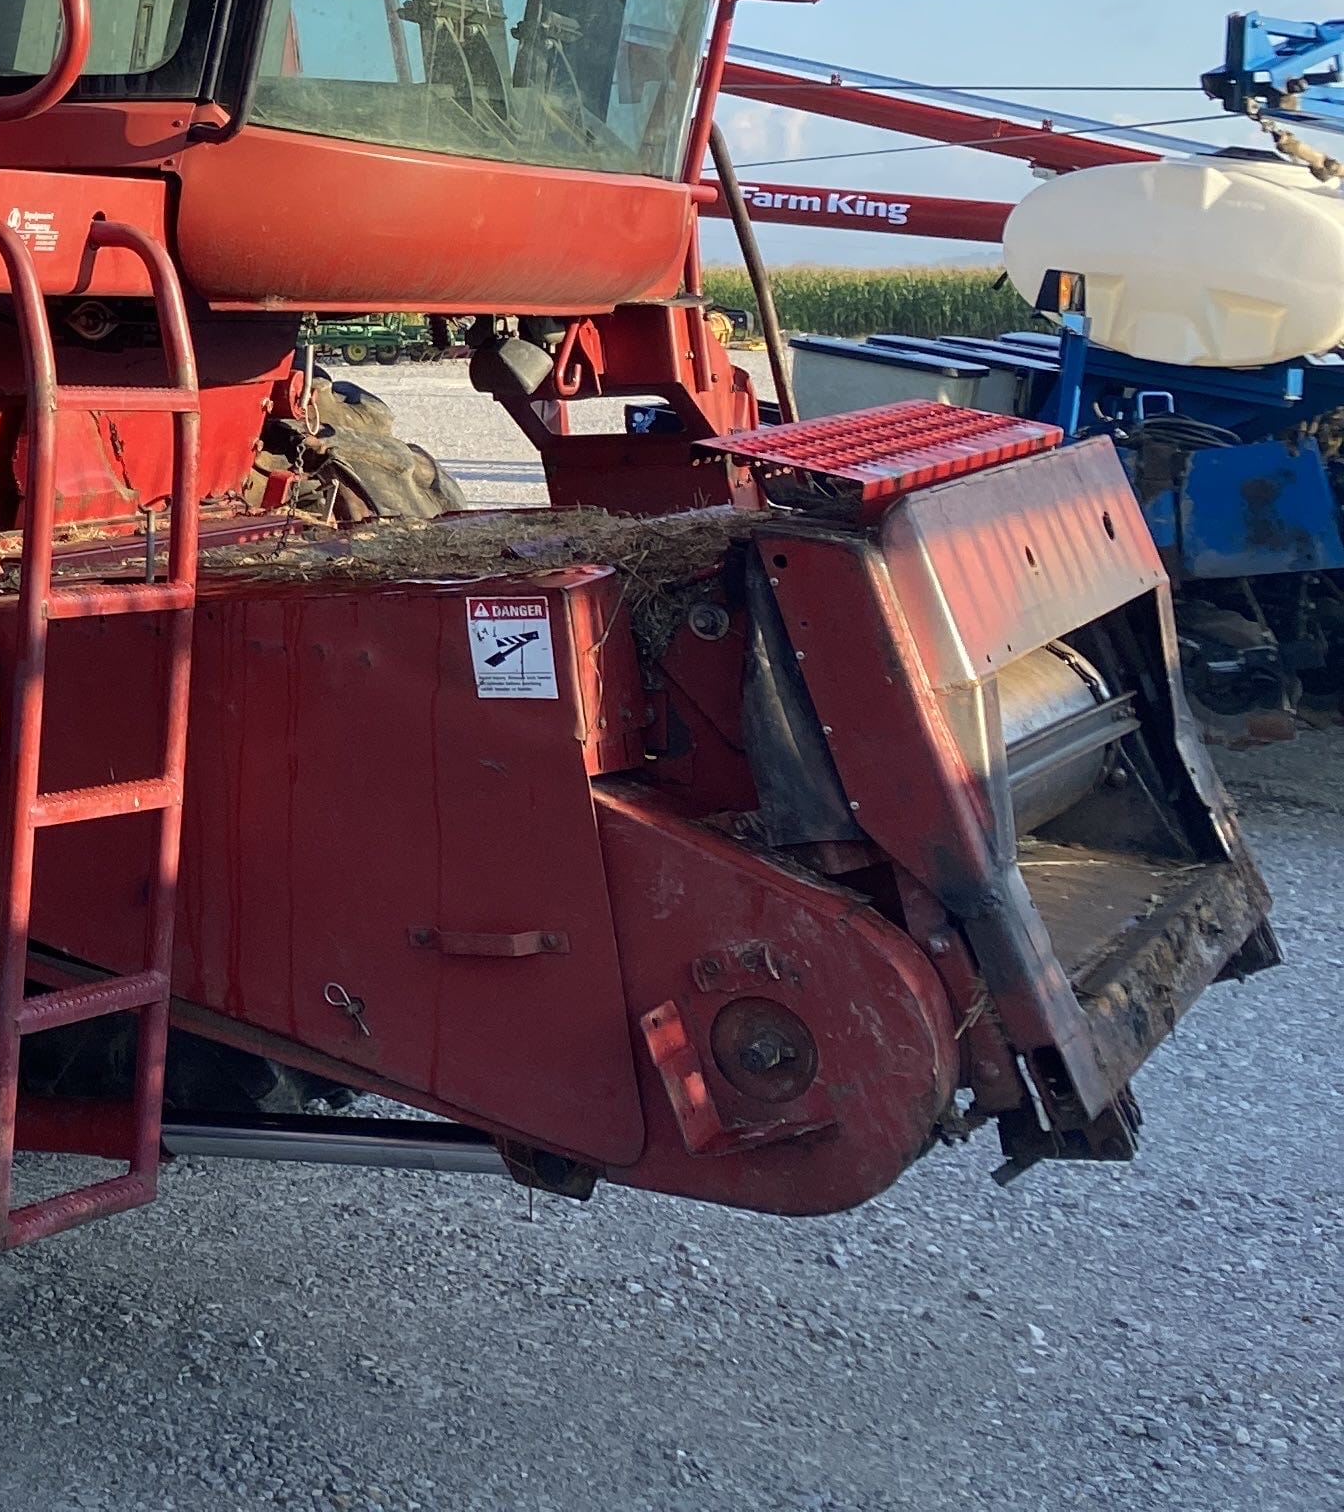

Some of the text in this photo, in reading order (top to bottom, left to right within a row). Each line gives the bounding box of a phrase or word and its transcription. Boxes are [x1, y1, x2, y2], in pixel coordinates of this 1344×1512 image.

[738, 185, 912, 226] Farm King
[491, 604, 543, 618] DANGER
